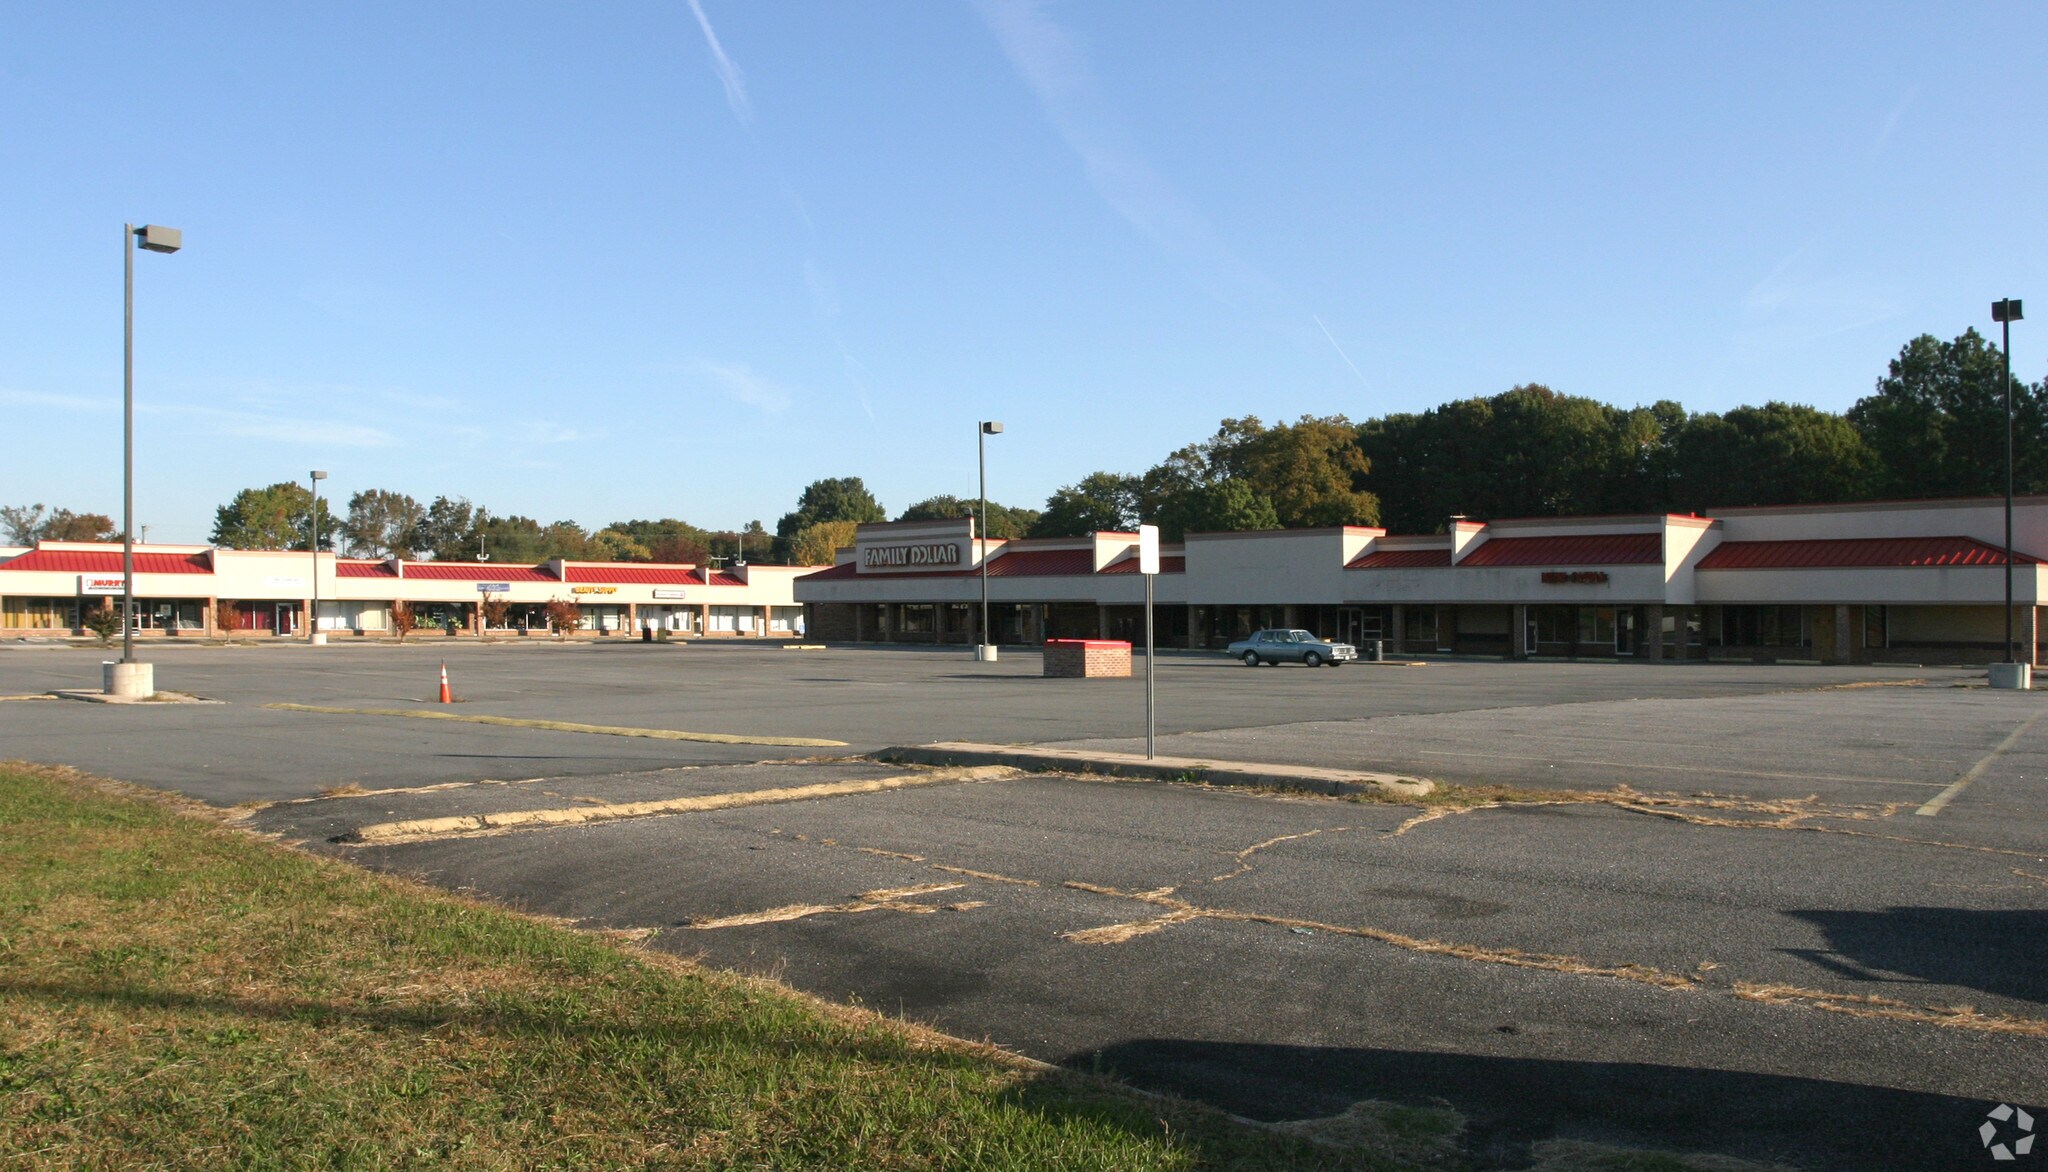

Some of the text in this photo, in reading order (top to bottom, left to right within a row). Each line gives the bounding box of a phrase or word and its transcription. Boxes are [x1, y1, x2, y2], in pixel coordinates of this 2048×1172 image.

[864, 543, 958, 567] FAMILY DOLLAR
[94, 579, 133, 587] MURRY
